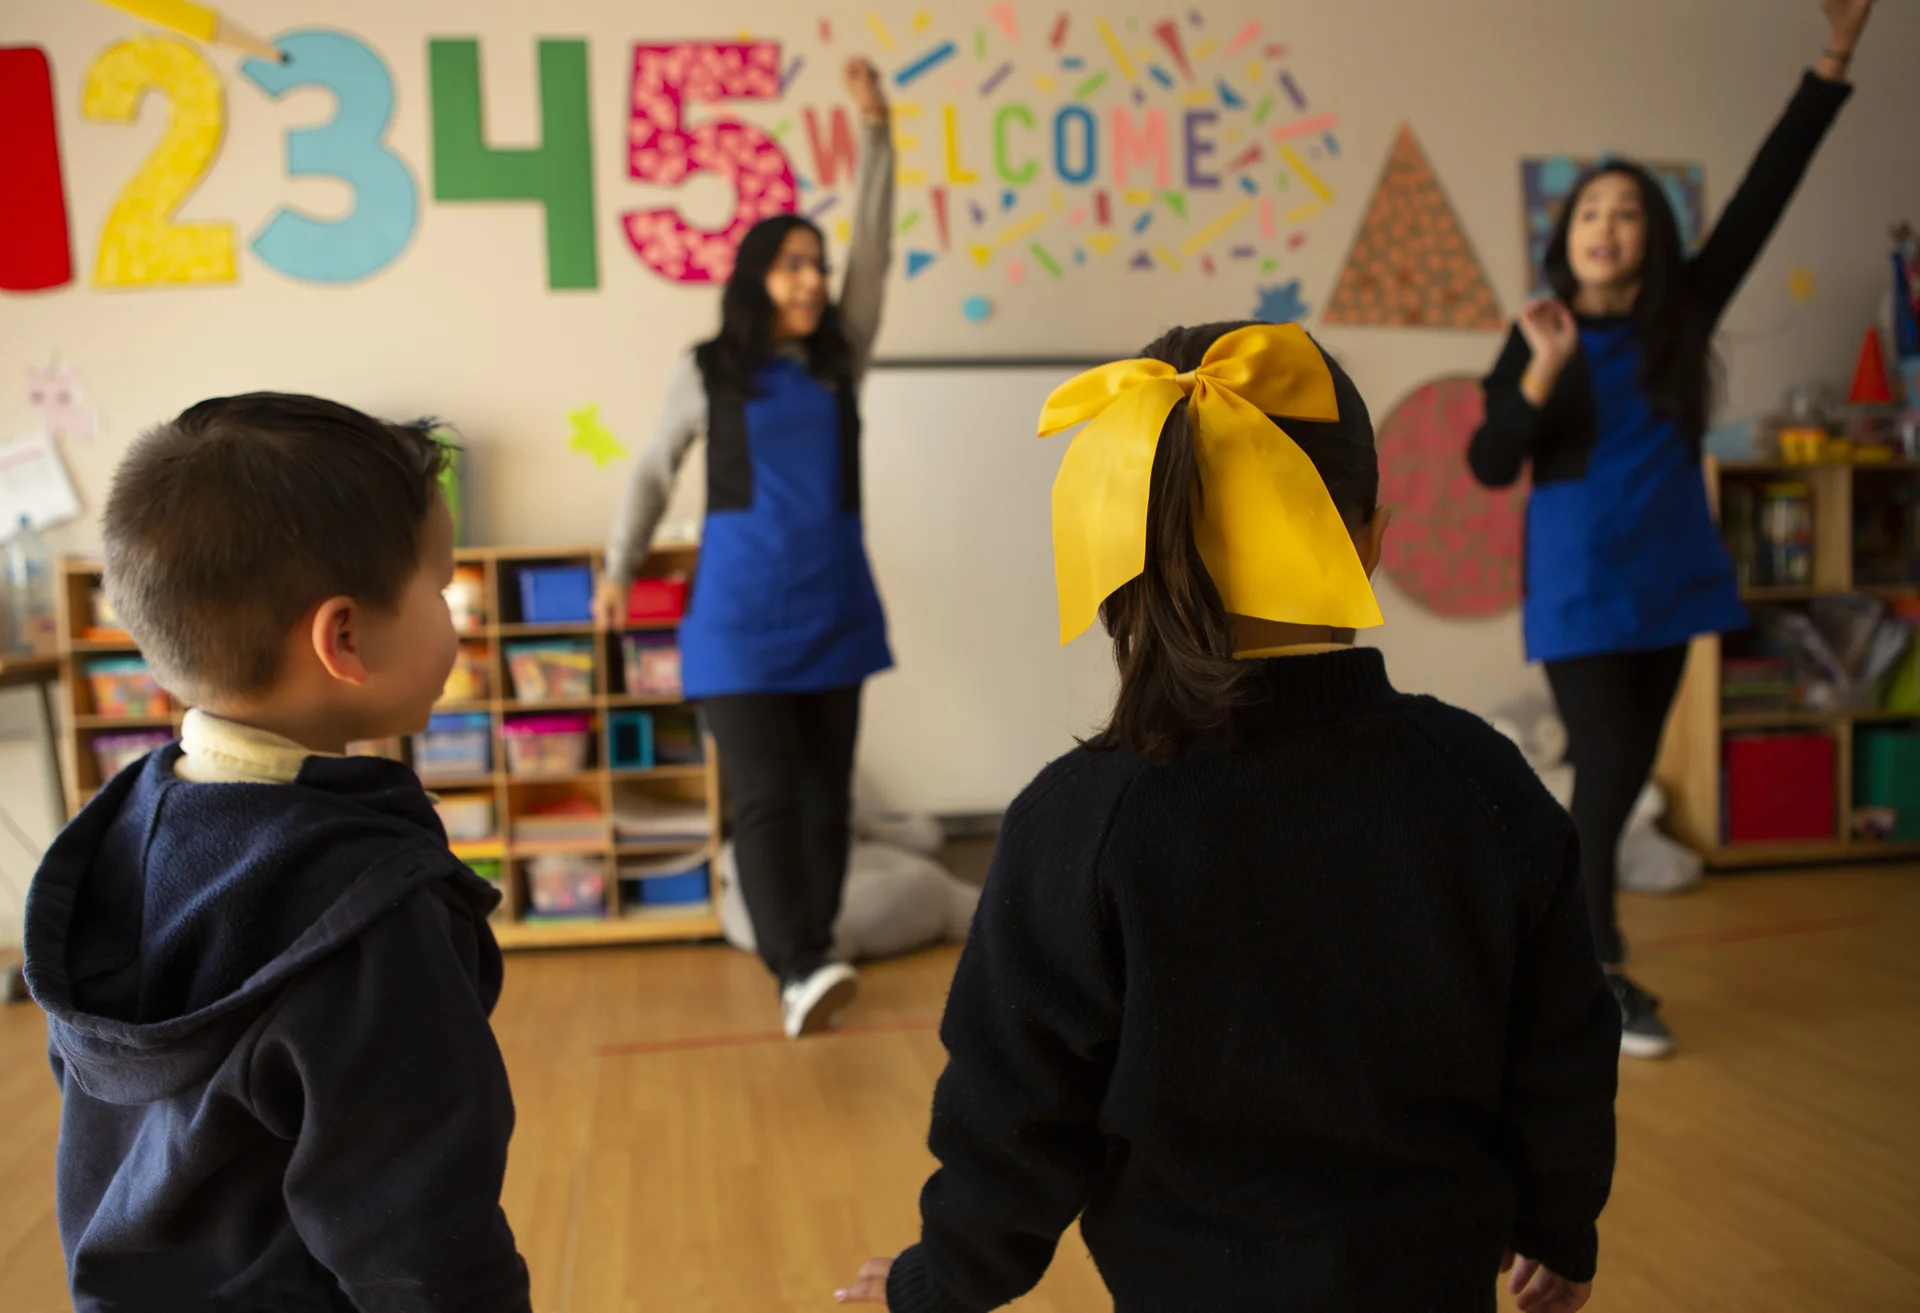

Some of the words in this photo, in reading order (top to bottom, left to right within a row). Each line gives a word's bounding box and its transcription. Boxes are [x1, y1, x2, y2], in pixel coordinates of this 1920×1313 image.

[80, 34, 239, 289] 2
[240, 29, 419, 284] 3
[428, 38, 599, 290] 4
[619, 40, 799, 285] 5
[802, 103, 1223, 188] WELCOME
